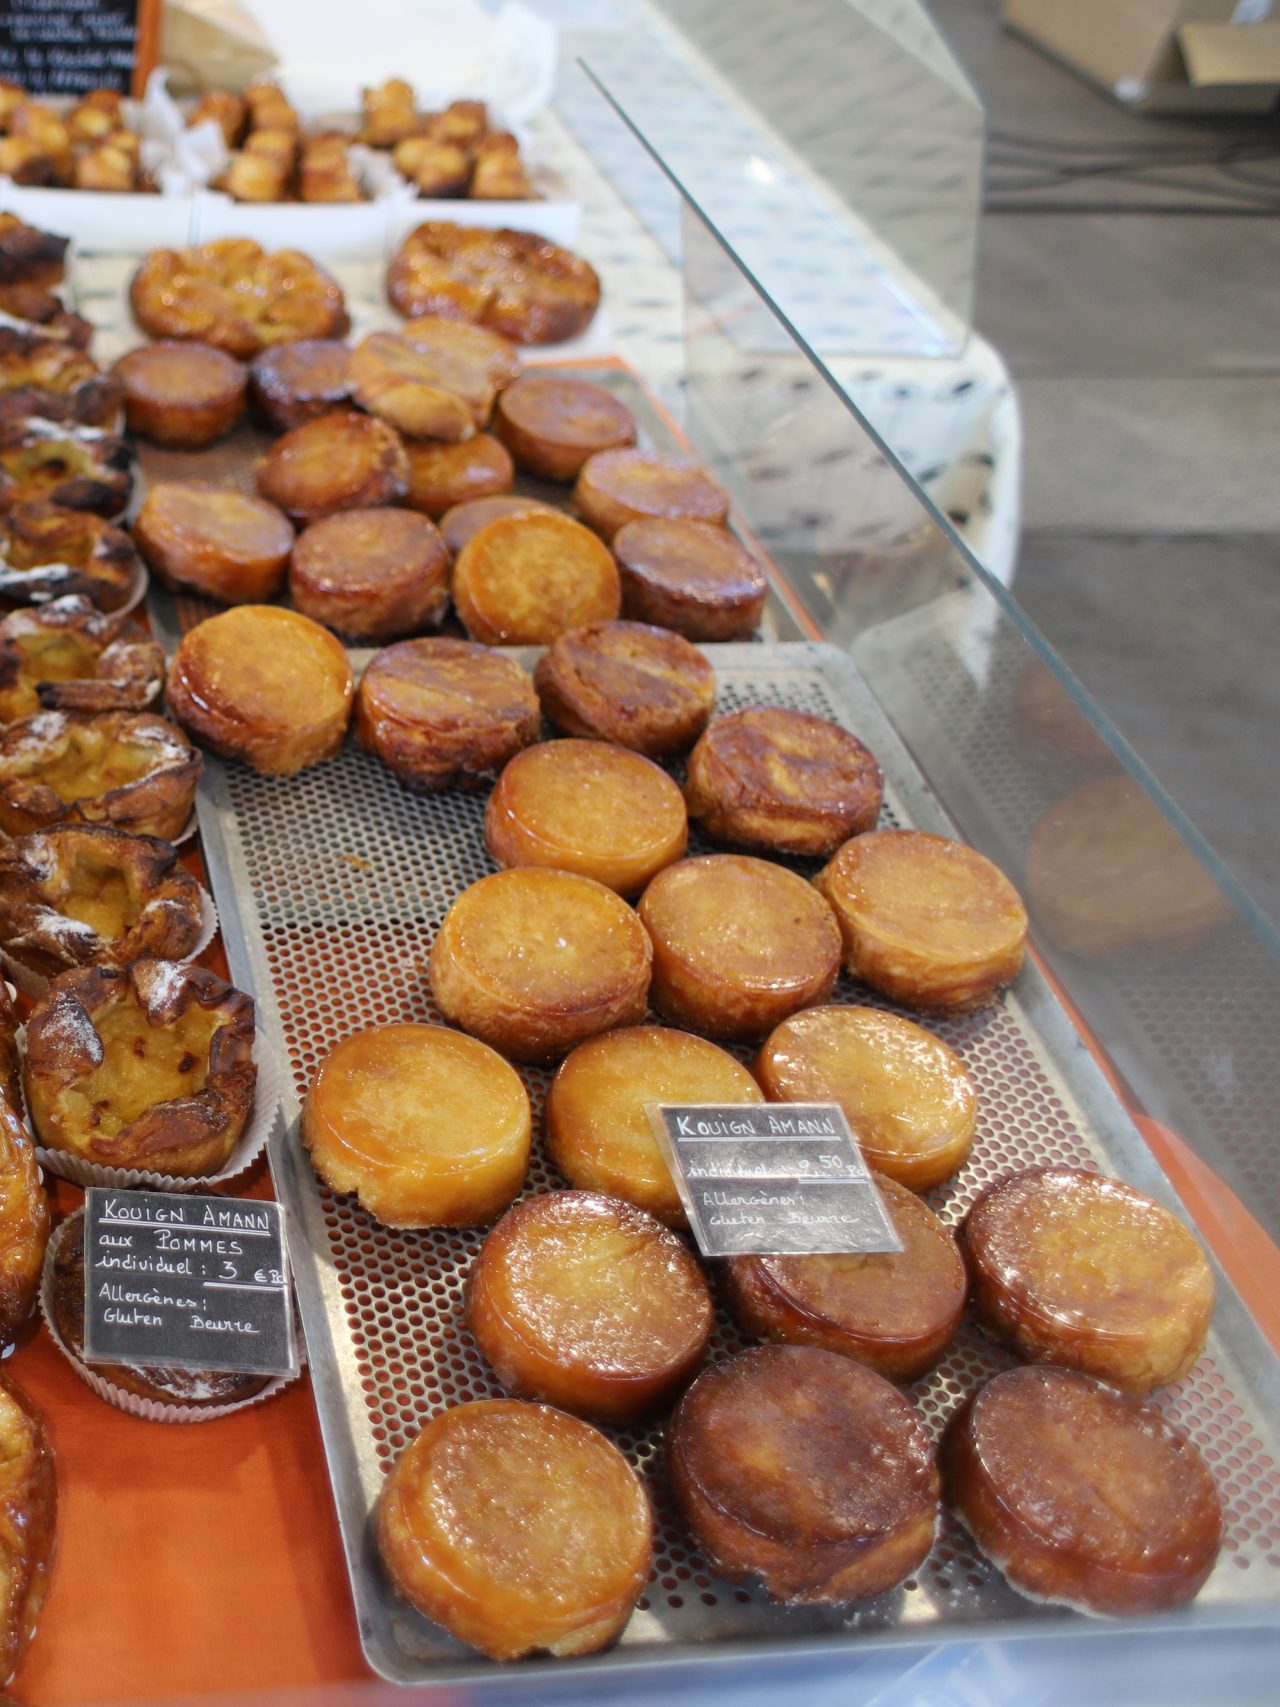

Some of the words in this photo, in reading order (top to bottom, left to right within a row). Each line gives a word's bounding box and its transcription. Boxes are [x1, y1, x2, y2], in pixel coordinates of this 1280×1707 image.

[676, 1114, 756, 1135] KOUIGN
[769, 1115, 835, 1134] AMANN
[104, 1199, 184, 1223] KOUIGN
[203, 1204, 270, 1229] AMANN
[98, 1234, 133, 1248] aux
[154, 1229, 243, 1255] POMMES
[218, 1261, 238, 1280] 3
[103, 1308, 162, 1327] Gluten
[190, 1315, 261, 1333] Beurre
